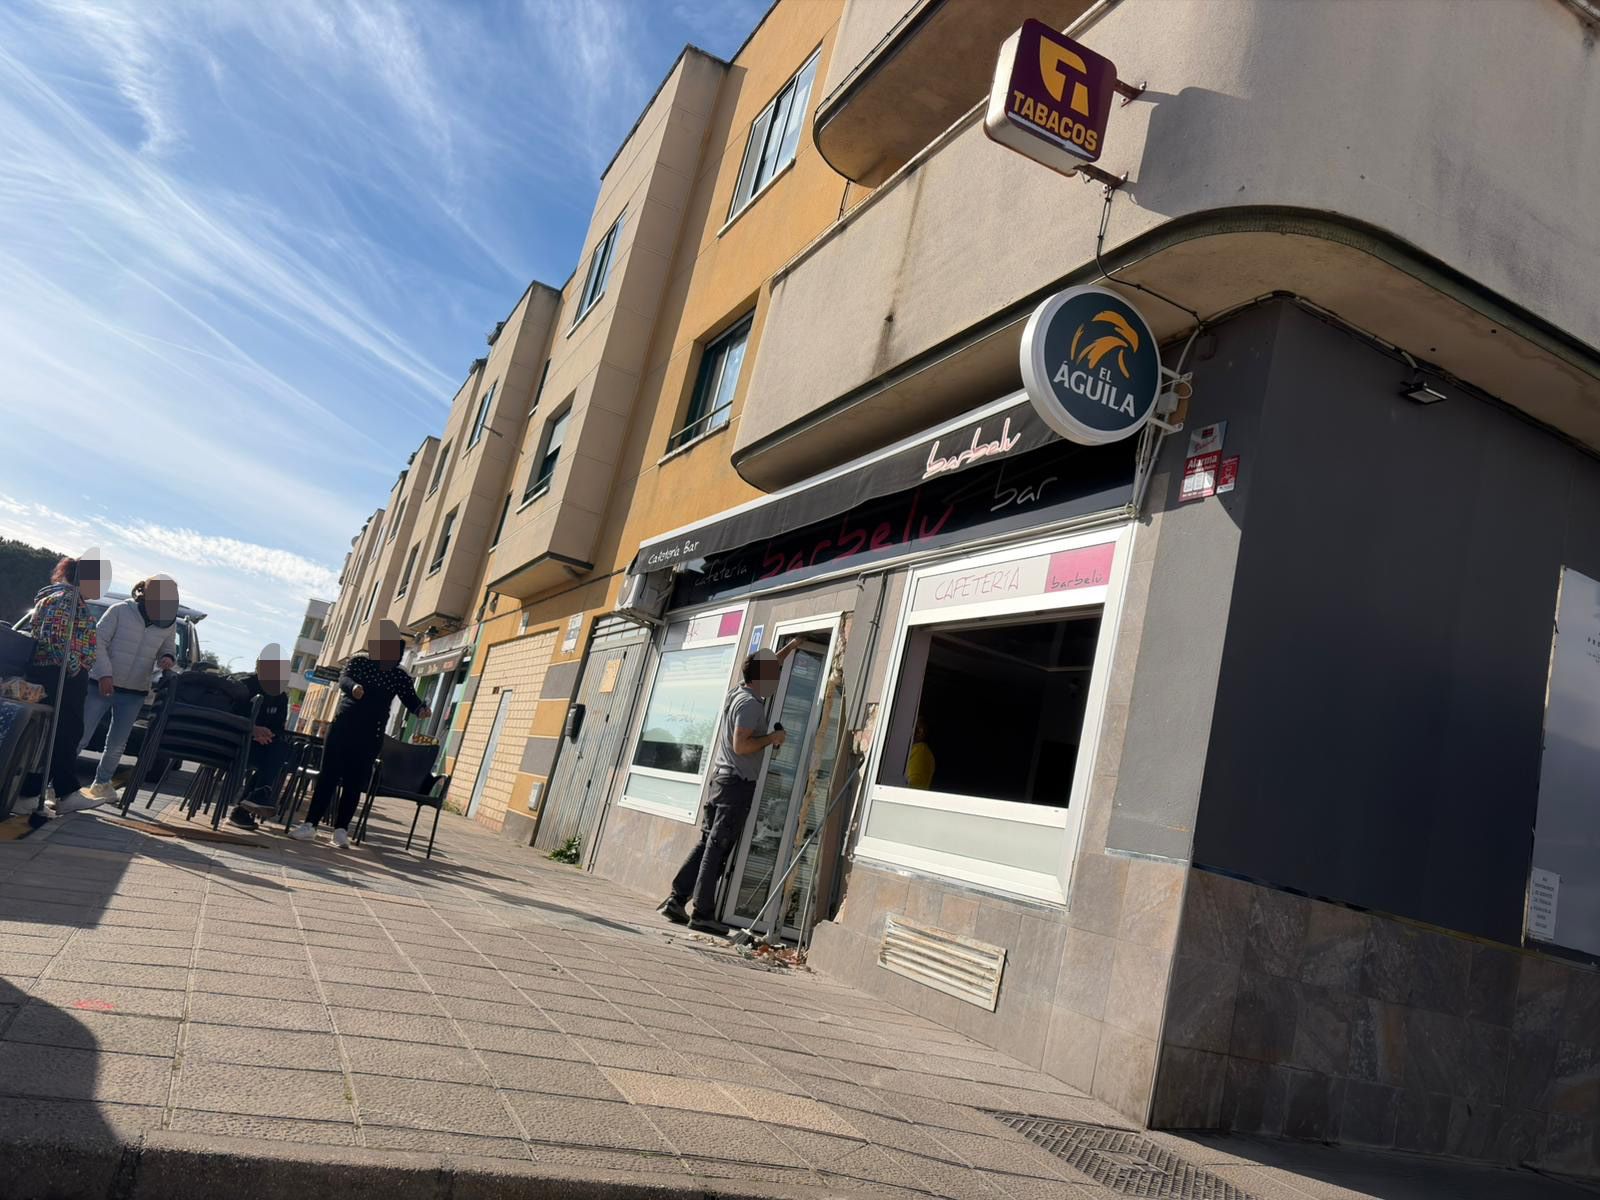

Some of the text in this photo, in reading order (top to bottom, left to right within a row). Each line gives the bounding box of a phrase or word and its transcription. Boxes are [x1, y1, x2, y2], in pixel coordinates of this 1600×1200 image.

[1013, 89, 1098, 151] TABACOS
[1053, 360, 1135, 418] ÁGUILA
[1099, 366, 1112, 383] EL
[990, 462, 1058, 512] bar
[683, 540, 700, 554] Bar
[934, 567, 1020, 601] CAFETERÍA
